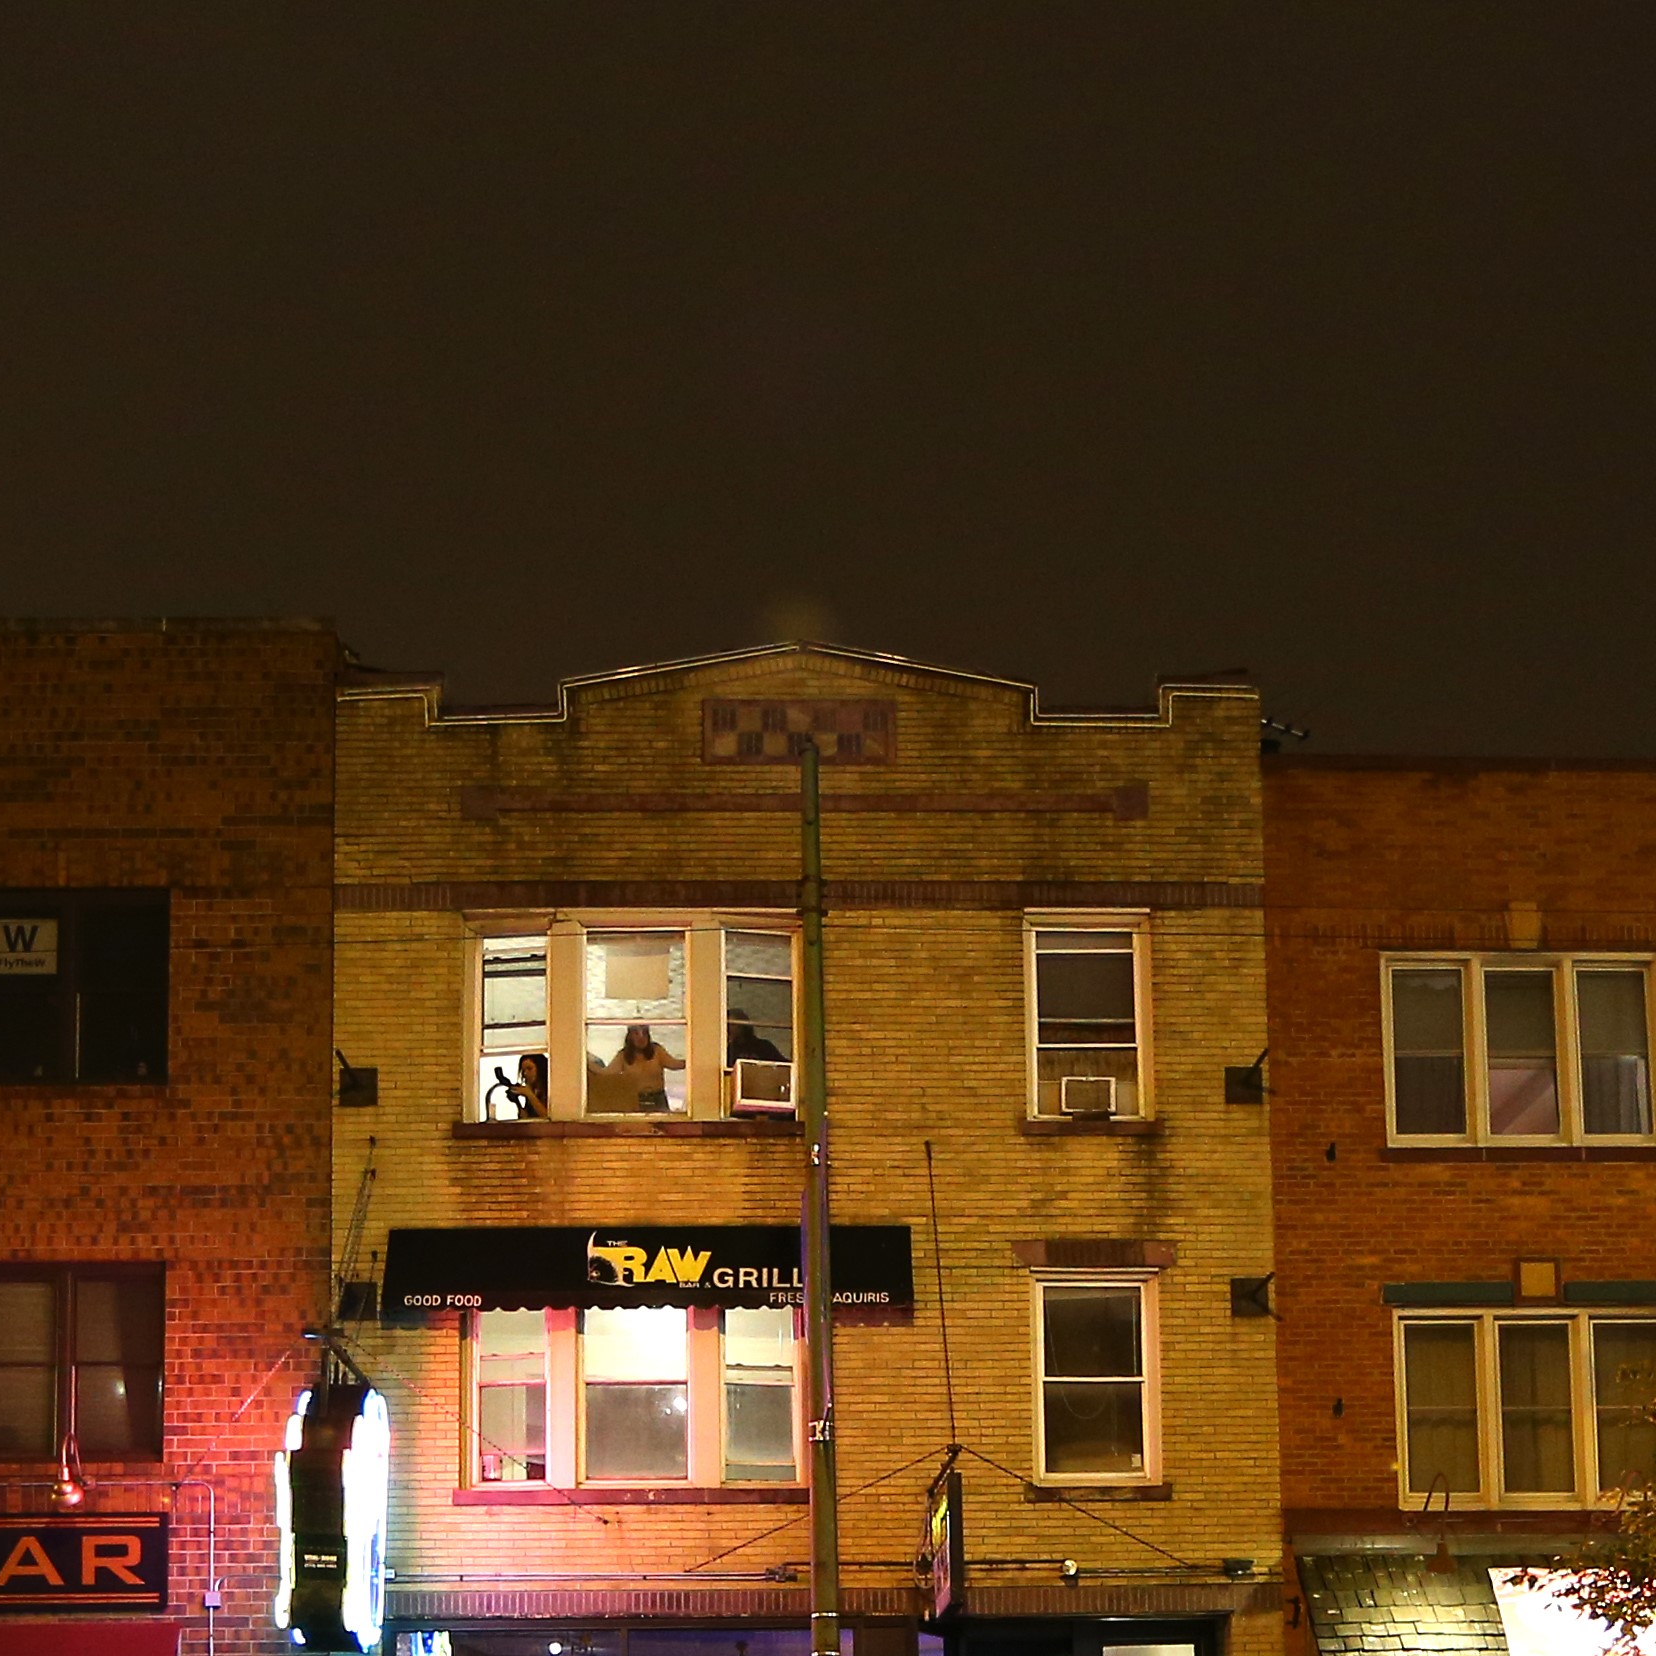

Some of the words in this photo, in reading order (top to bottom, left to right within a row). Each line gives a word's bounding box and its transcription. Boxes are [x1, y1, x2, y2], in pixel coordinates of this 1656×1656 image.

[3, 925, 40, 953] W
[594, 1245, 711, 1284] RAW
[712, 1267, 803, 1288] GRILL
[403, 1295, 441, 1306] GOOD
[446, 1295, 482, 1306] FOOD
[769, 1292, 804, 1303] FRES
[832, 1291, 889, 1303] AQUIRIS
